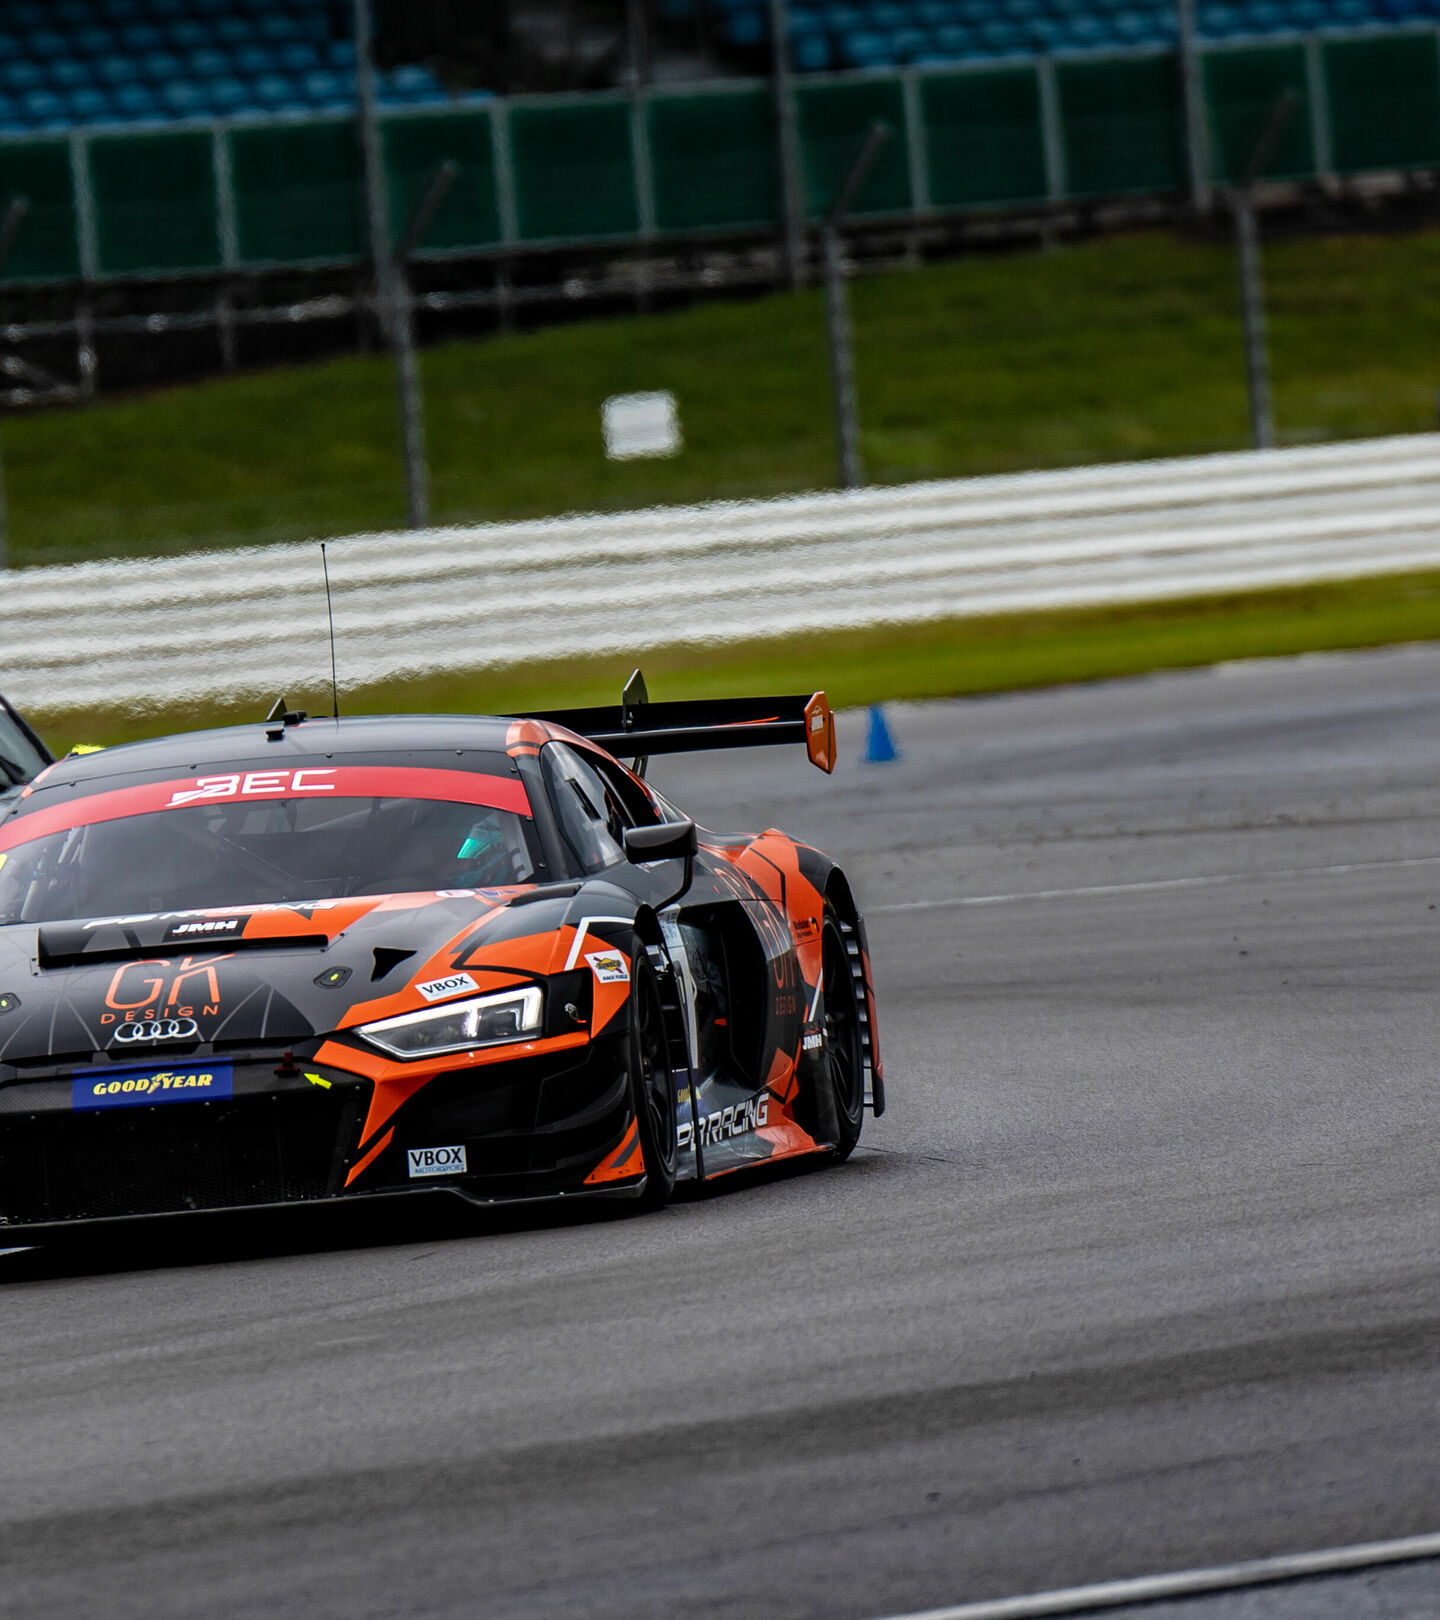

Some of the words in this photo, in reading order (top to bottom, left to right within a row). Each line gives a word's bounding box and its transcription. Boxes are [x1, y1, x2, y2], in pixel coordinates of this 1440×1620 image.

[172, 920, 238, 934] JMH
[105, 953, 236, 1009] GK
[422, 977, 470, 995] VBOX
[100, 1005, 219, 1024] DESIGN
[93, 1073, 213, 1095] GOODYEAR
[706, 1092, 770, 1147] RACING
[410, 1148, 462, 1167] VBOX
